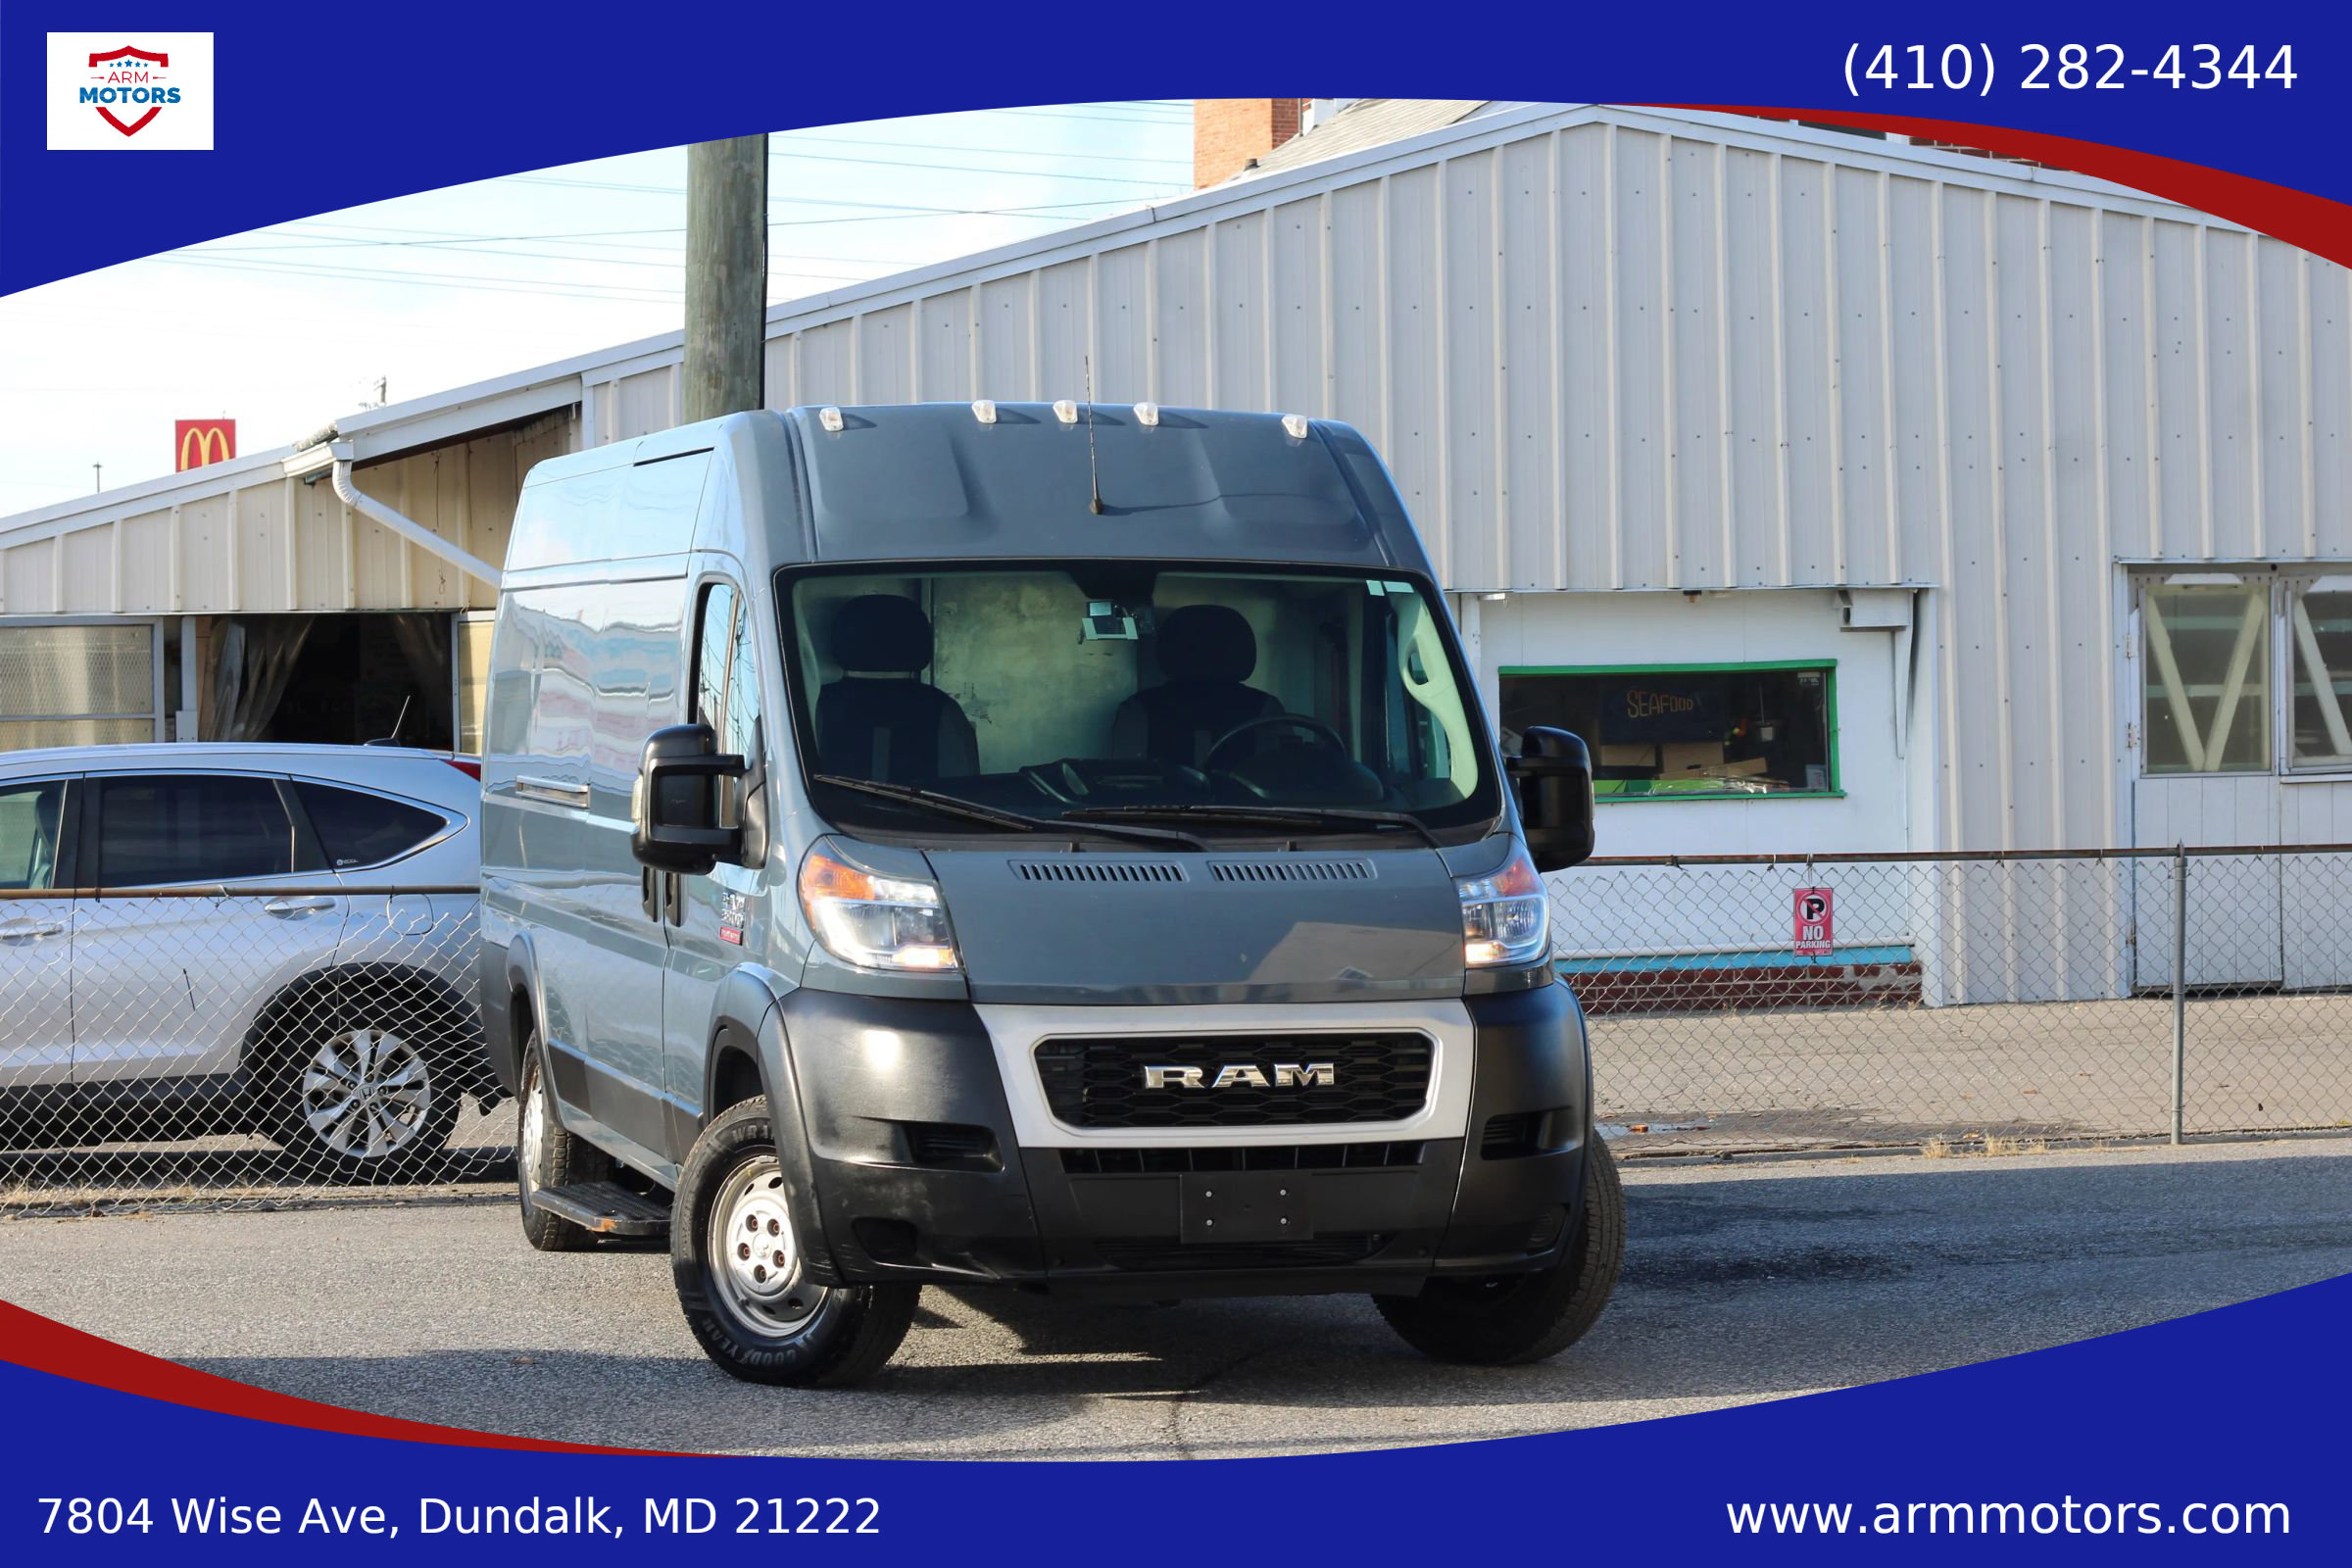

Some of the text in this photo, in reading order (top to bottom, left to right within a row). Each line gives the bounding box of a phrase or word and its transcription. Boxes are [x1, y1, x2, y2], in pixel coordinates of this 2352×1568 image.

[1627, 690, 1694, 718] SEAFOOD
[1802, 925, 1825, 941] NO
[1795, 940, 1831, 950] PARKING
[1145, 1062, 1335, 1089] RAM
